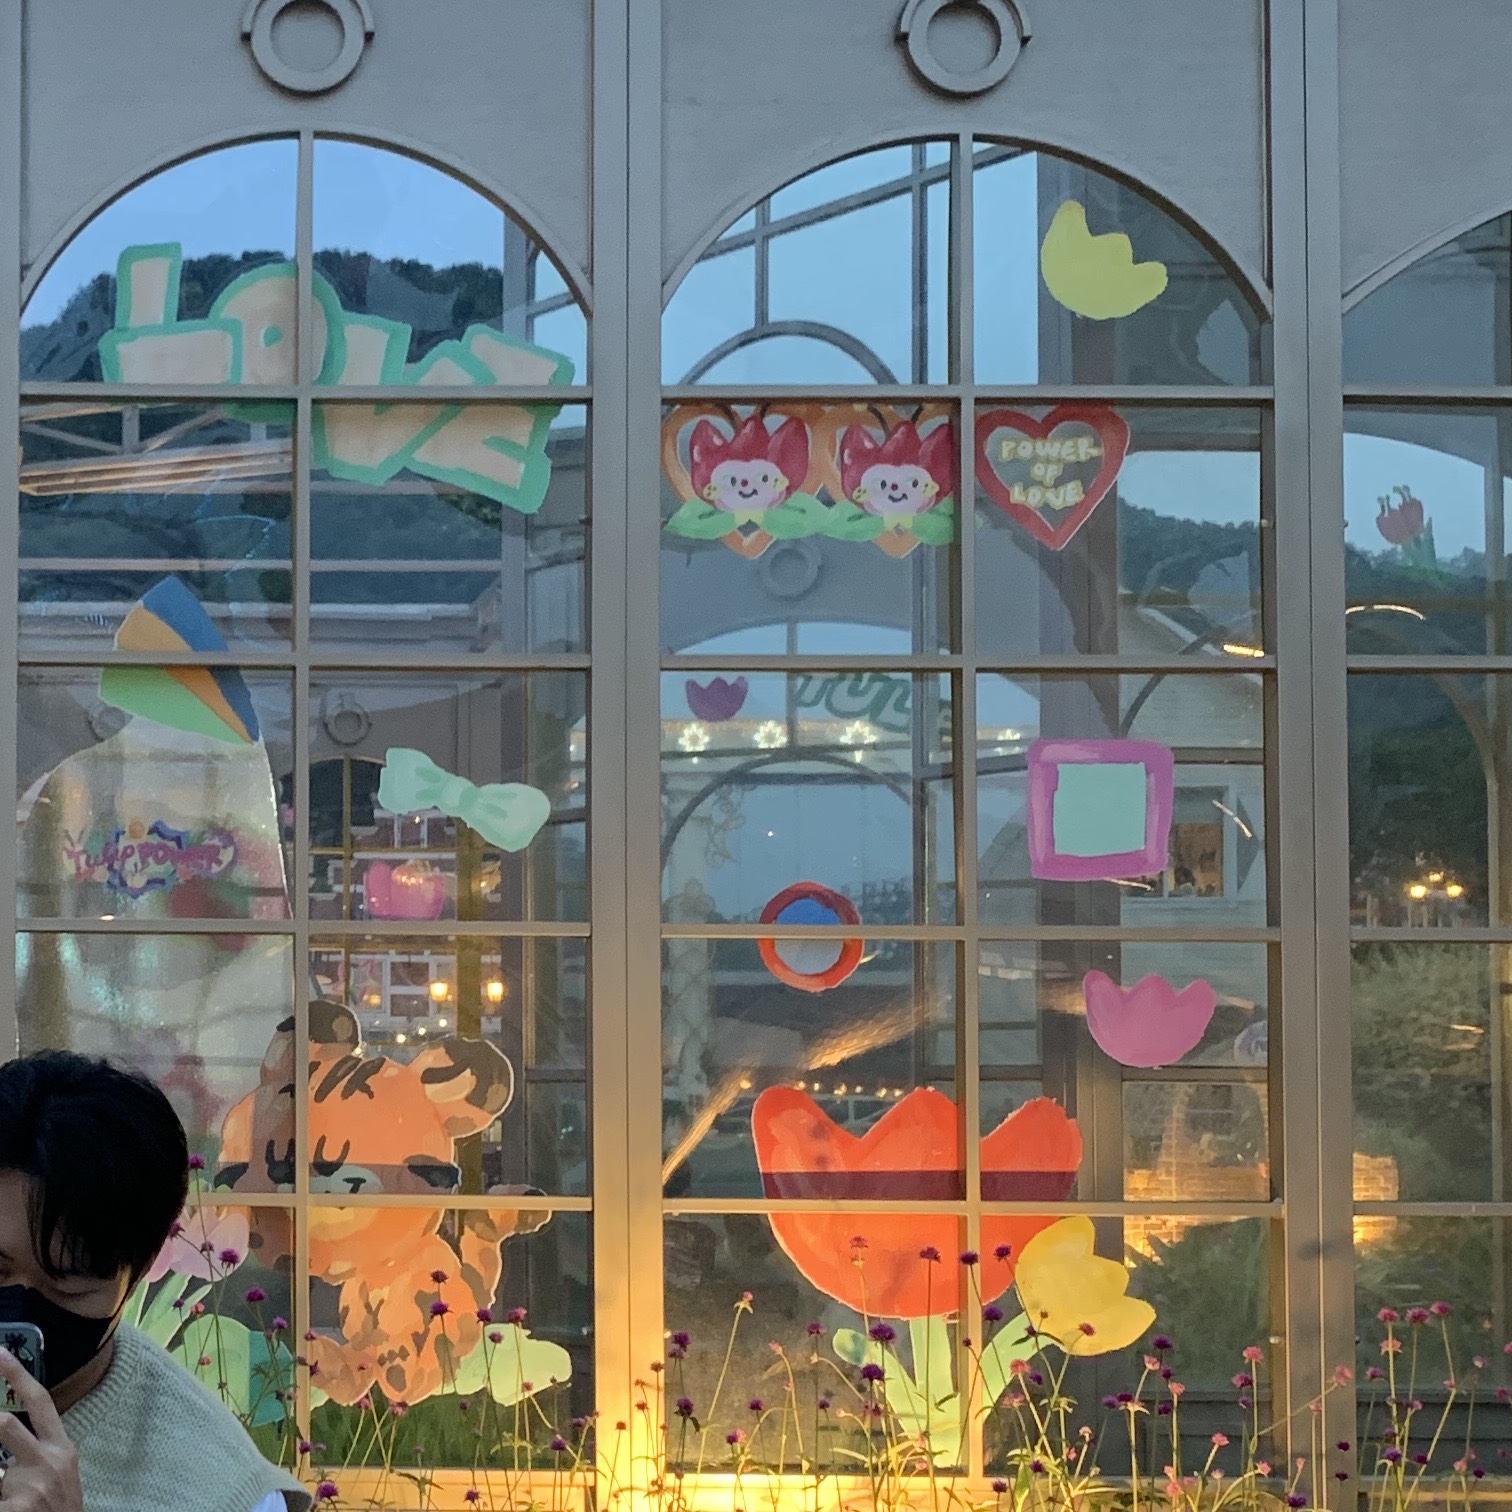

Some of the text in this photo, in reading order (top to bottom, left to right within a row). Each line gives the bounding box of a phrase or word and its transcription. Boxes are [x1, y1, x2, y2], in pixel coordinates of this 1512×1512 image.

[99, 242, 575, 514] LOVE
[998, 435, 1102, 463] POWER
[1030, 461, 1064, 488] OF
[1010, 481, 1085, 511] LOVE
